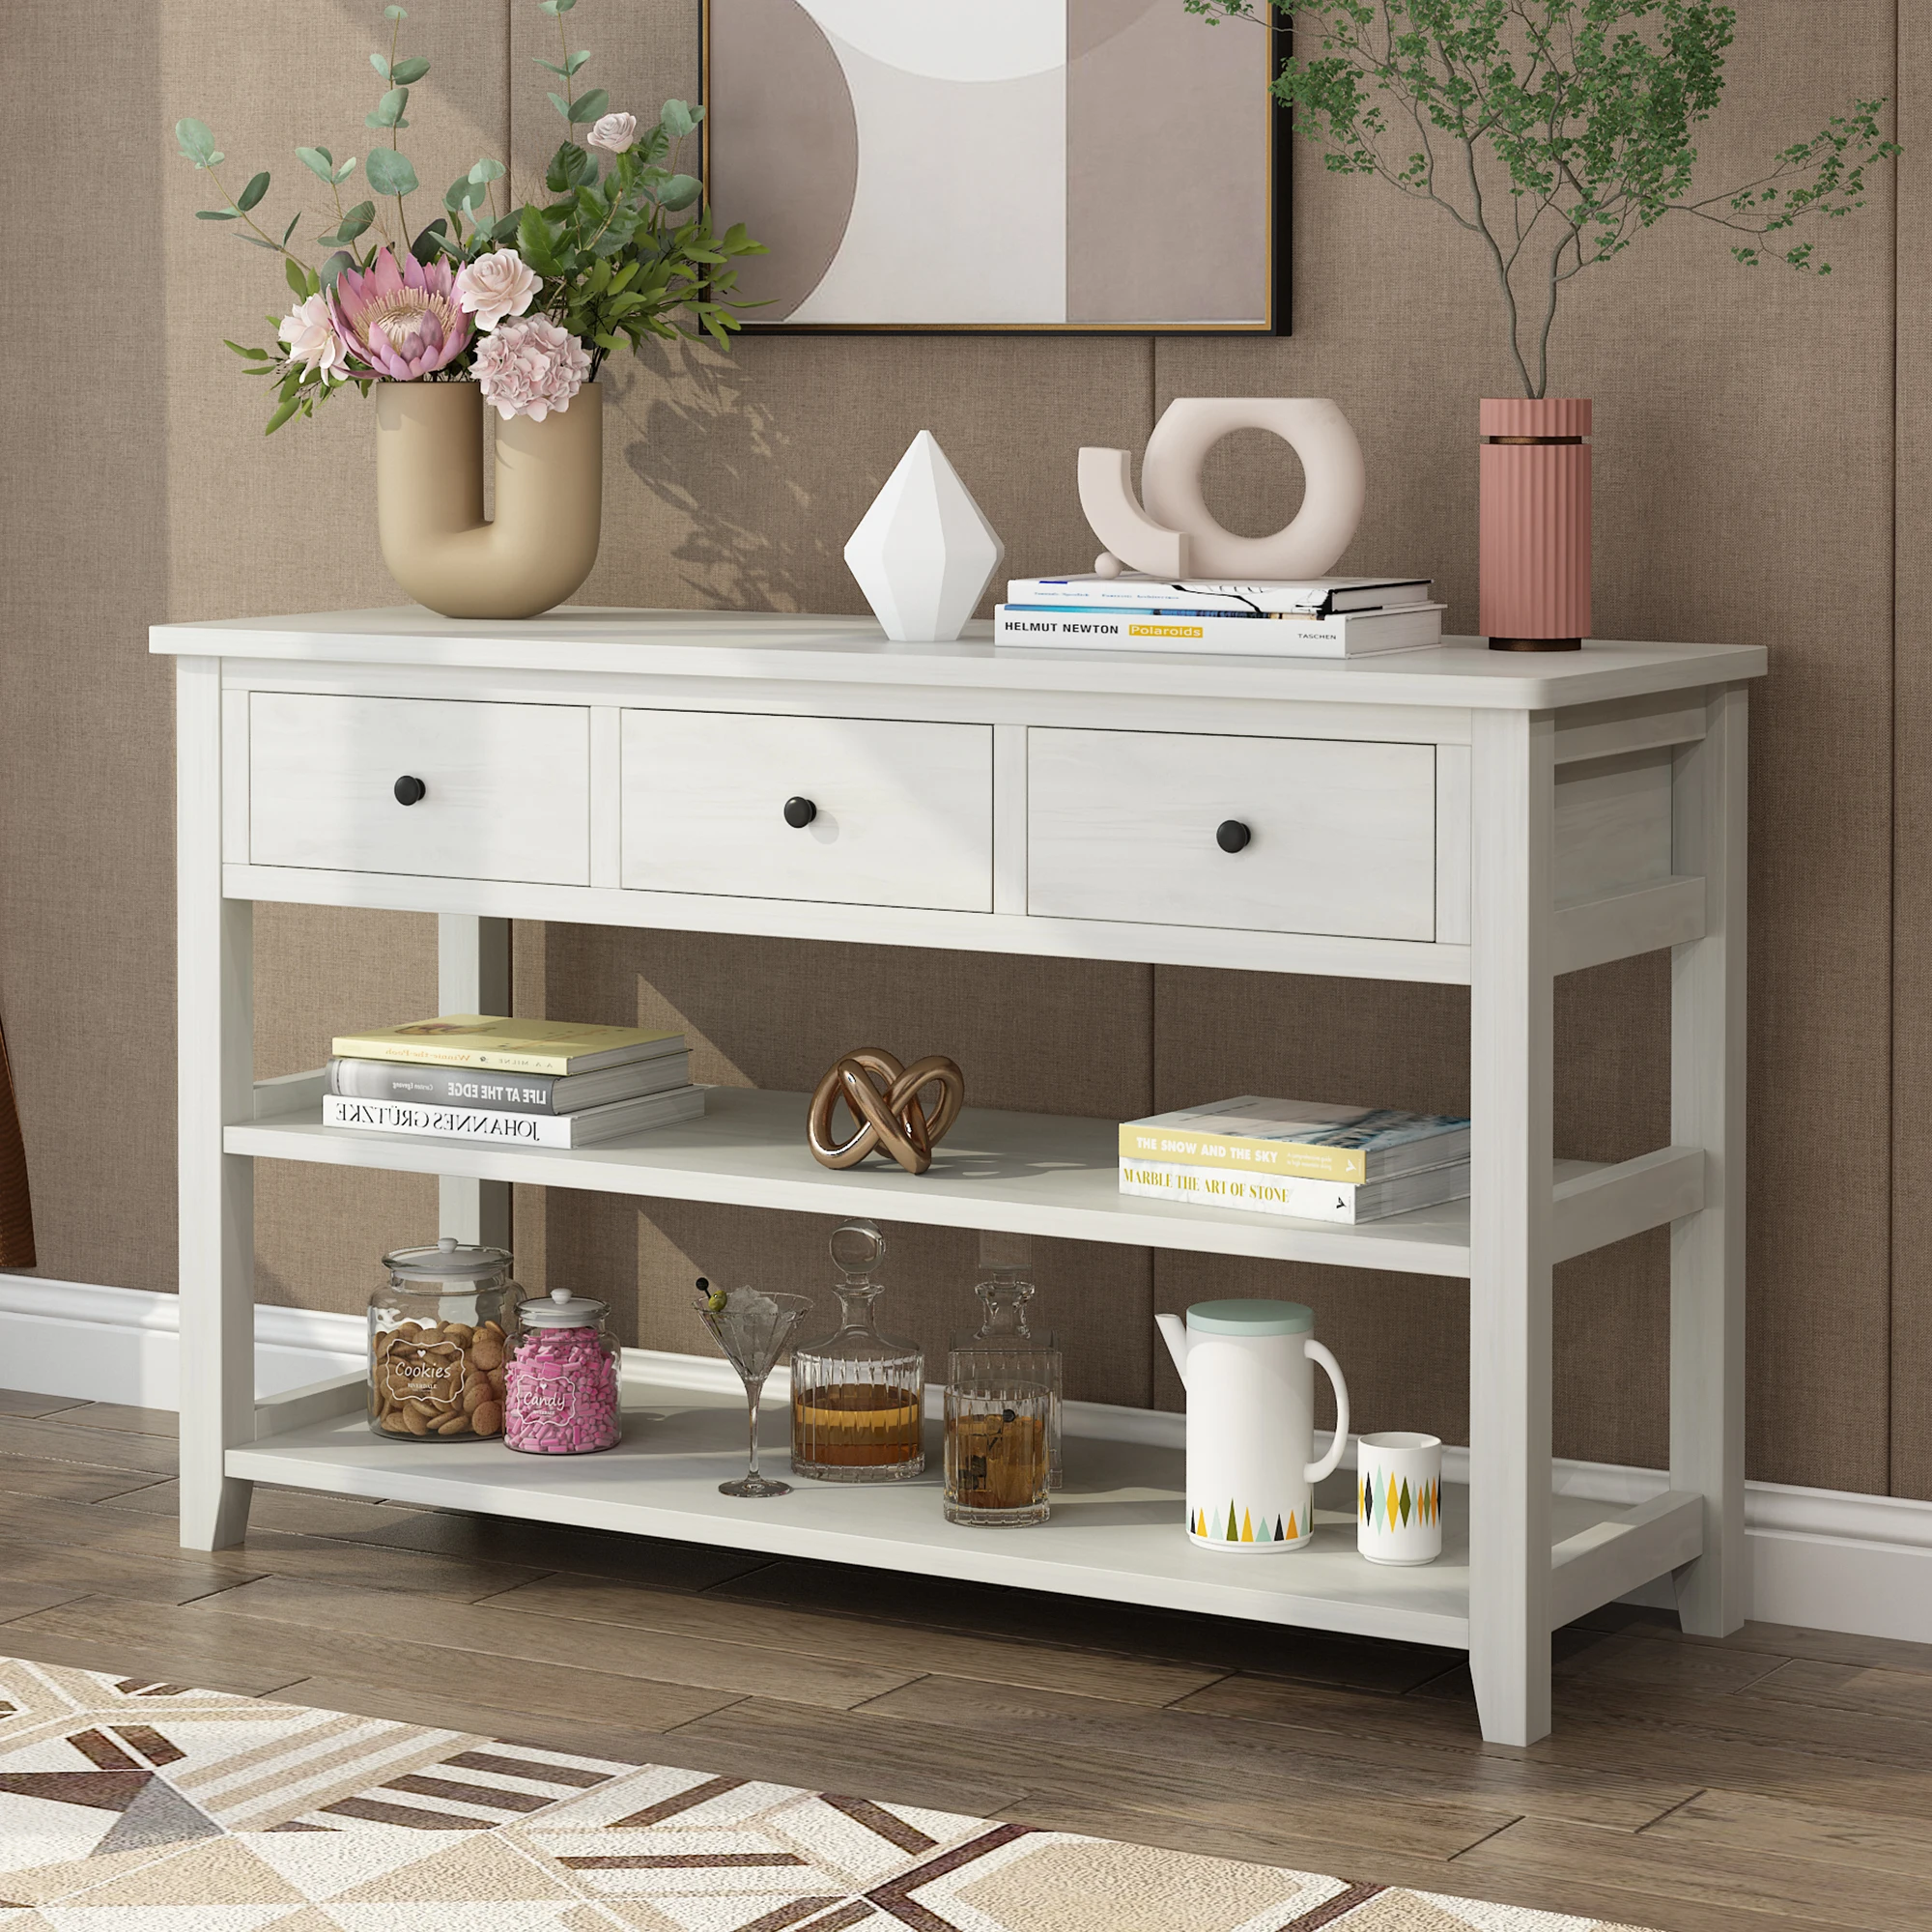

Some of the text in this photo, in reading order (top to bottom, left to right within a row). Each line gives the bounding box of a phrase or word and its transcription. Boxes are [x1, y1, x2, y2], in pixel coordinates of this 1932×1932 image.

[1005, 621, 1202, 637] HELMUT NEWTON Polaroids
[1136, 1136, 1278, 1164] THE SNOW AND THE SKY
[1123, 1167, 1290, 1204] MARBLE THE ART OF STONE
[395, 1361, 451, 1378] Cookies
[524, 1391, 565, 1411] Candy
